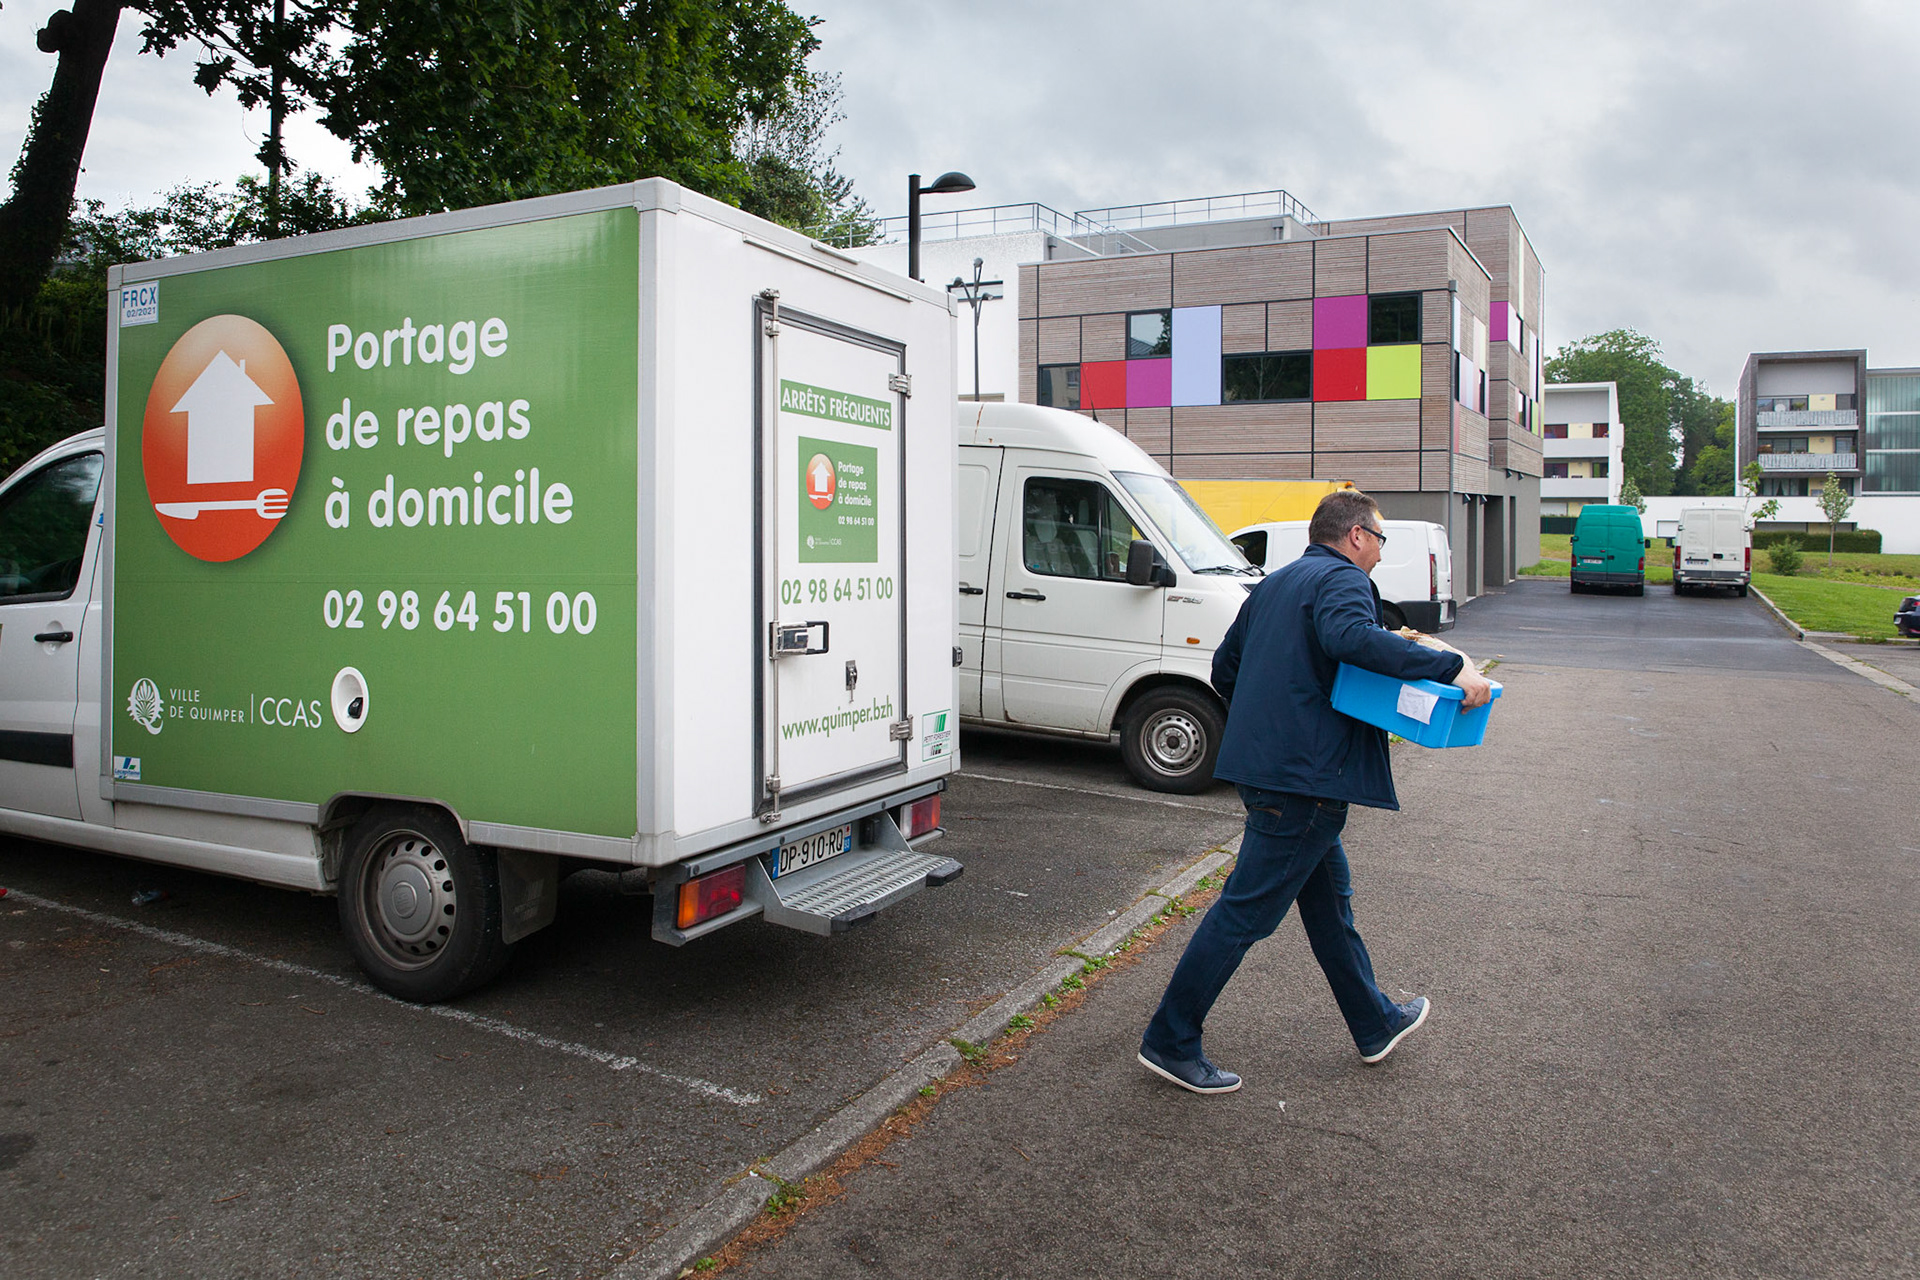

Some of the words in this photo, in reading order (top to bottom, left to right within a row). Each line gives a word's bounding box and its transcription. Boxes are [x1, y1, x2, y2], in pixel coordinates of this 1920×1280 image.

[122, 286, 157, 309] FRCX
[126, 306, 156, 318] 02/2021
[327, 317, 509, 375] Portage
[782, 387, 826, 415] ARRÊTS
[829, 395, 890, 427] FRÉQUENTS
[325, 398, 380, 450] de
[397, 398, 532, 458] repas
[838, 461, 864, 477] Portage
[324, 476, 350, 529] à
[368, 467, 574, 528] domicile
[838, 477, 847, 489] de
[848, 480, 867, 492] repas
[838, 493, 843, 504] à
[844, 494, 872, 506] domicile
[838, 516, 845, 524] 02
[846, 516, 853, 525] 98
[853, 517, 860, 525] 64
[861, 517, 867, 526] 51
[867, 517, 875, 526] 00
[781, 579, 802, 605] 02
[808, 578, 828, 603] 98
[833, 578, 852, 602] 64
[857, 577, 871, 601] 51
[876, 576, 893, 600] 00
[323, 589, 364, 630] 02
[377, 590, 421, 631] 98
[433, 590, 480, 632] 64
[492, 591, 532, 634] 51
[545, 591, 598, 635] 00
[169, 688, 200, 702] VILLE
[169, 705, 184, 719] DE
[189, 706, 245, 723] QUIMPER
[259, 697, 322, 729] CCAS
[782, 694, 893, 741] www.quimper.bzh
[780, 829, 843, 873] DP-910-RQ
